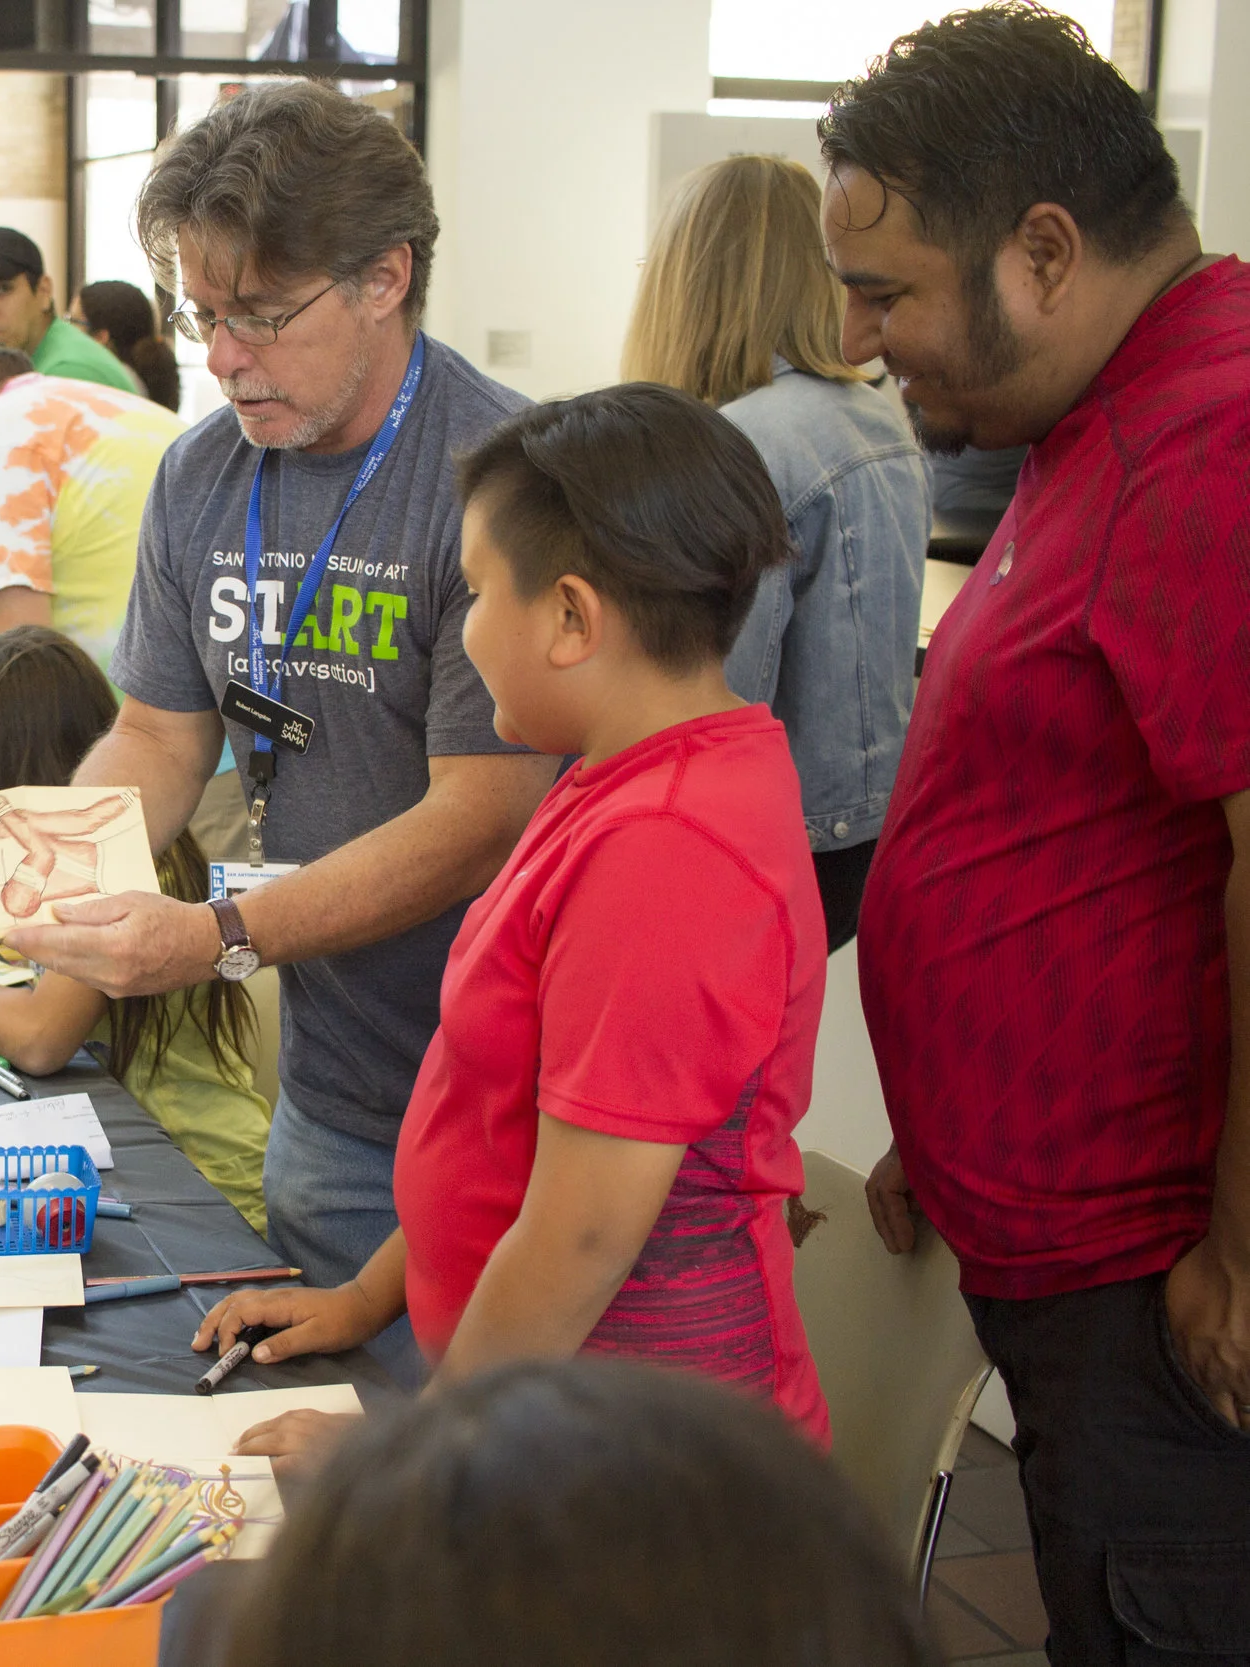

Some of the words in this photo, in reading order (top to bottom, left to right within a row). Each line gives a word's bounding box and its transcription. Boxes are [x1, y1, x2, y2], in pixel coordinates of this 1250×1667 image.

[212, 551, 245, 568] SAN
[259, 552, 306, 569] NTONIO
[364, 562, 383, 578] of
[383, 564, 409, 580] ART
[209, 576, 408, 661] START
[280, 729, 305, 748] SAMA
[213, 869, 223, 899] AFF
